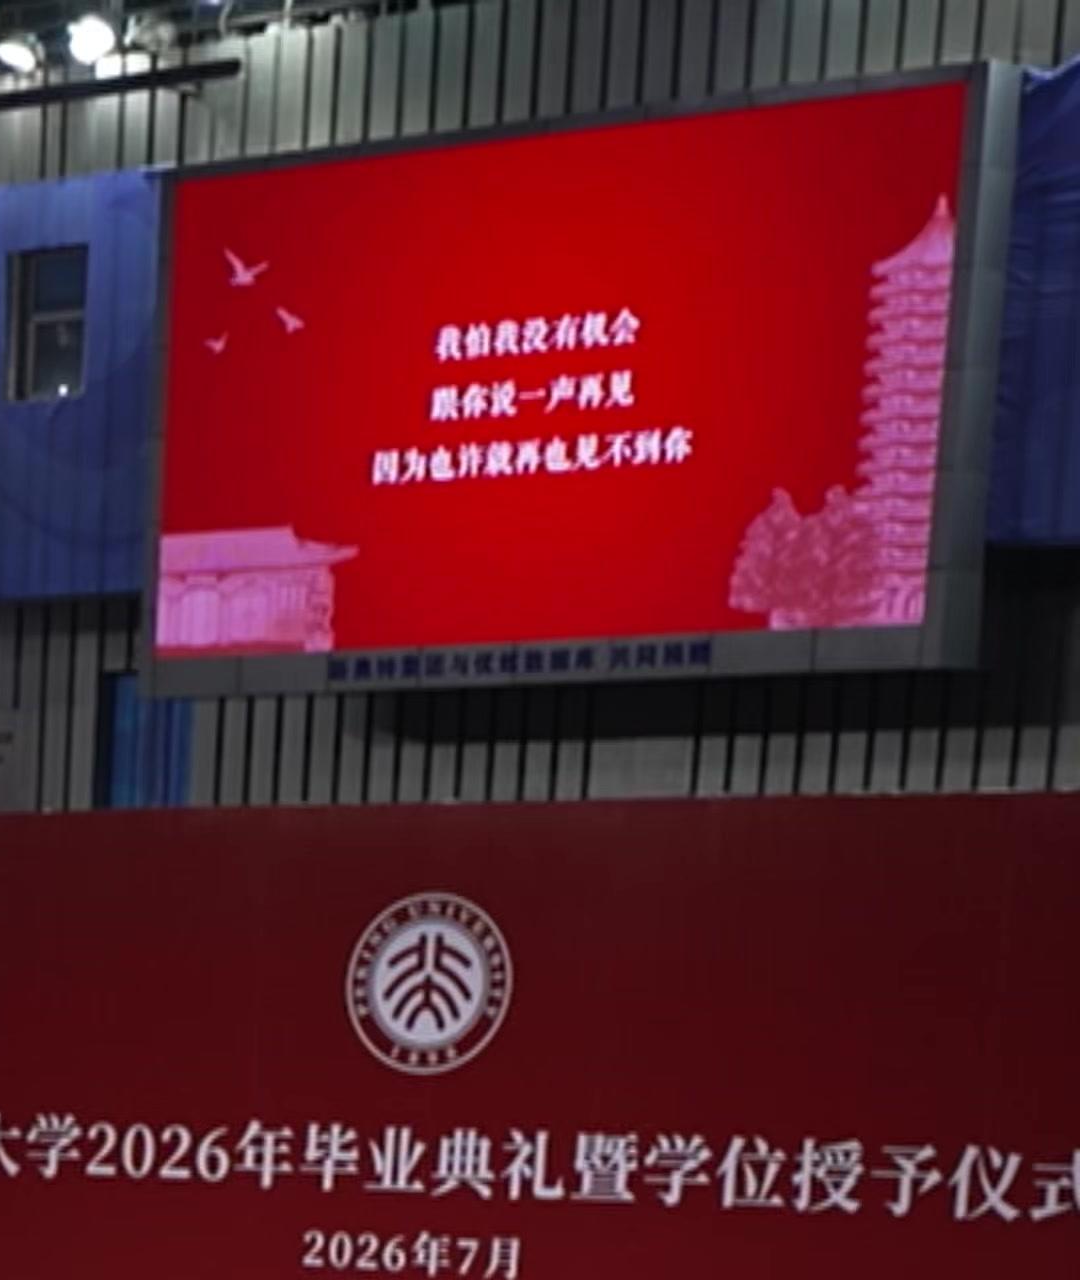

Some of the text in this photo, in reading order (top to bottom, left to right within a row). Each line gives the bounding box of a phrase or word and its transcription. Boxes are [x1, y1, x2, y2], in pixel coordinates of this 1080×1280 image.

[436, 307, 641, 362] 我怕我没有机会
[430, 370, 634, 421] 跟你说一声再见
[372, 426, 693, 485] 因为也许就再也见不到你
